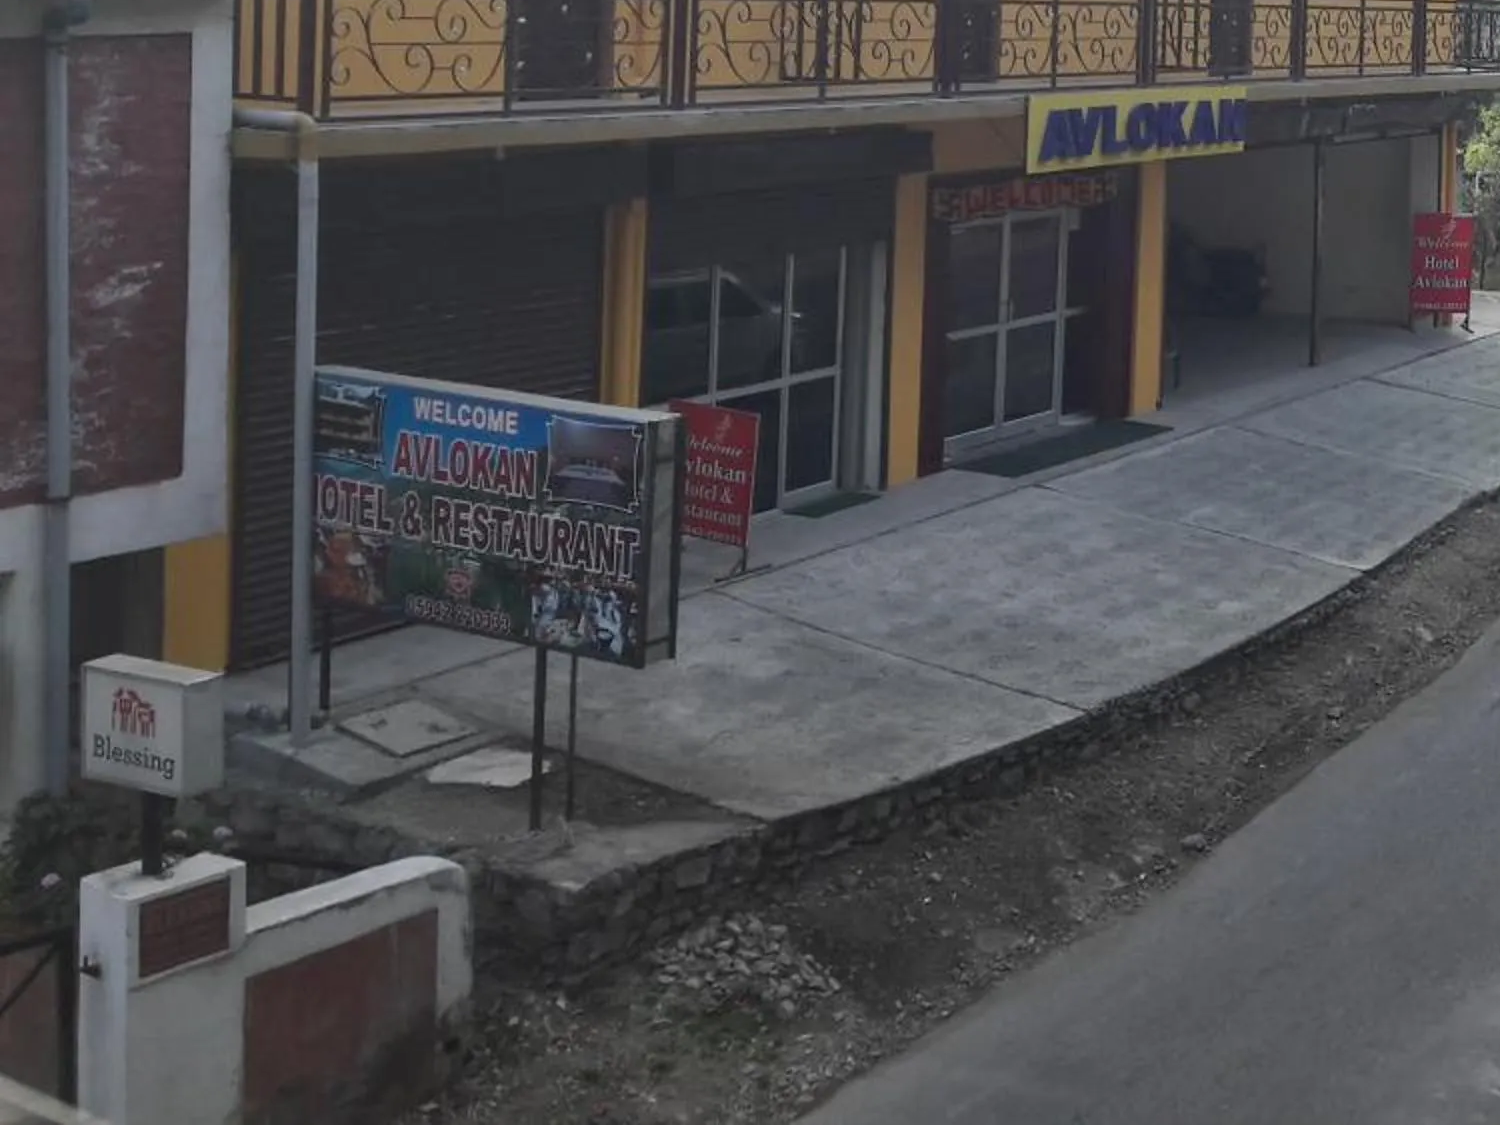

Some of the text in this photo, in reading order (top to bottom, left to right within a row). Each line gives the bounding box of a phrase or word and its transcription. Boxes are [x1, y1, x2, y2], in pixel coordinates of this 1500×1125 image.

[1037, 98, 1248, 163] AVLOKAN
[1424, 255, 1460, 270] Hotel
[413, 396, 519, 435] WELCOME
[392, 429, 538, 500] AVLOKAN
[688, 435, 743, 458] elcome
[685, 457, 746, 485] vlokan
[720, 486, 733, 504] &
[314, 474, 641, 582] OTEL & RESTAURANT
[92, 733, 176, 779] Blessing
